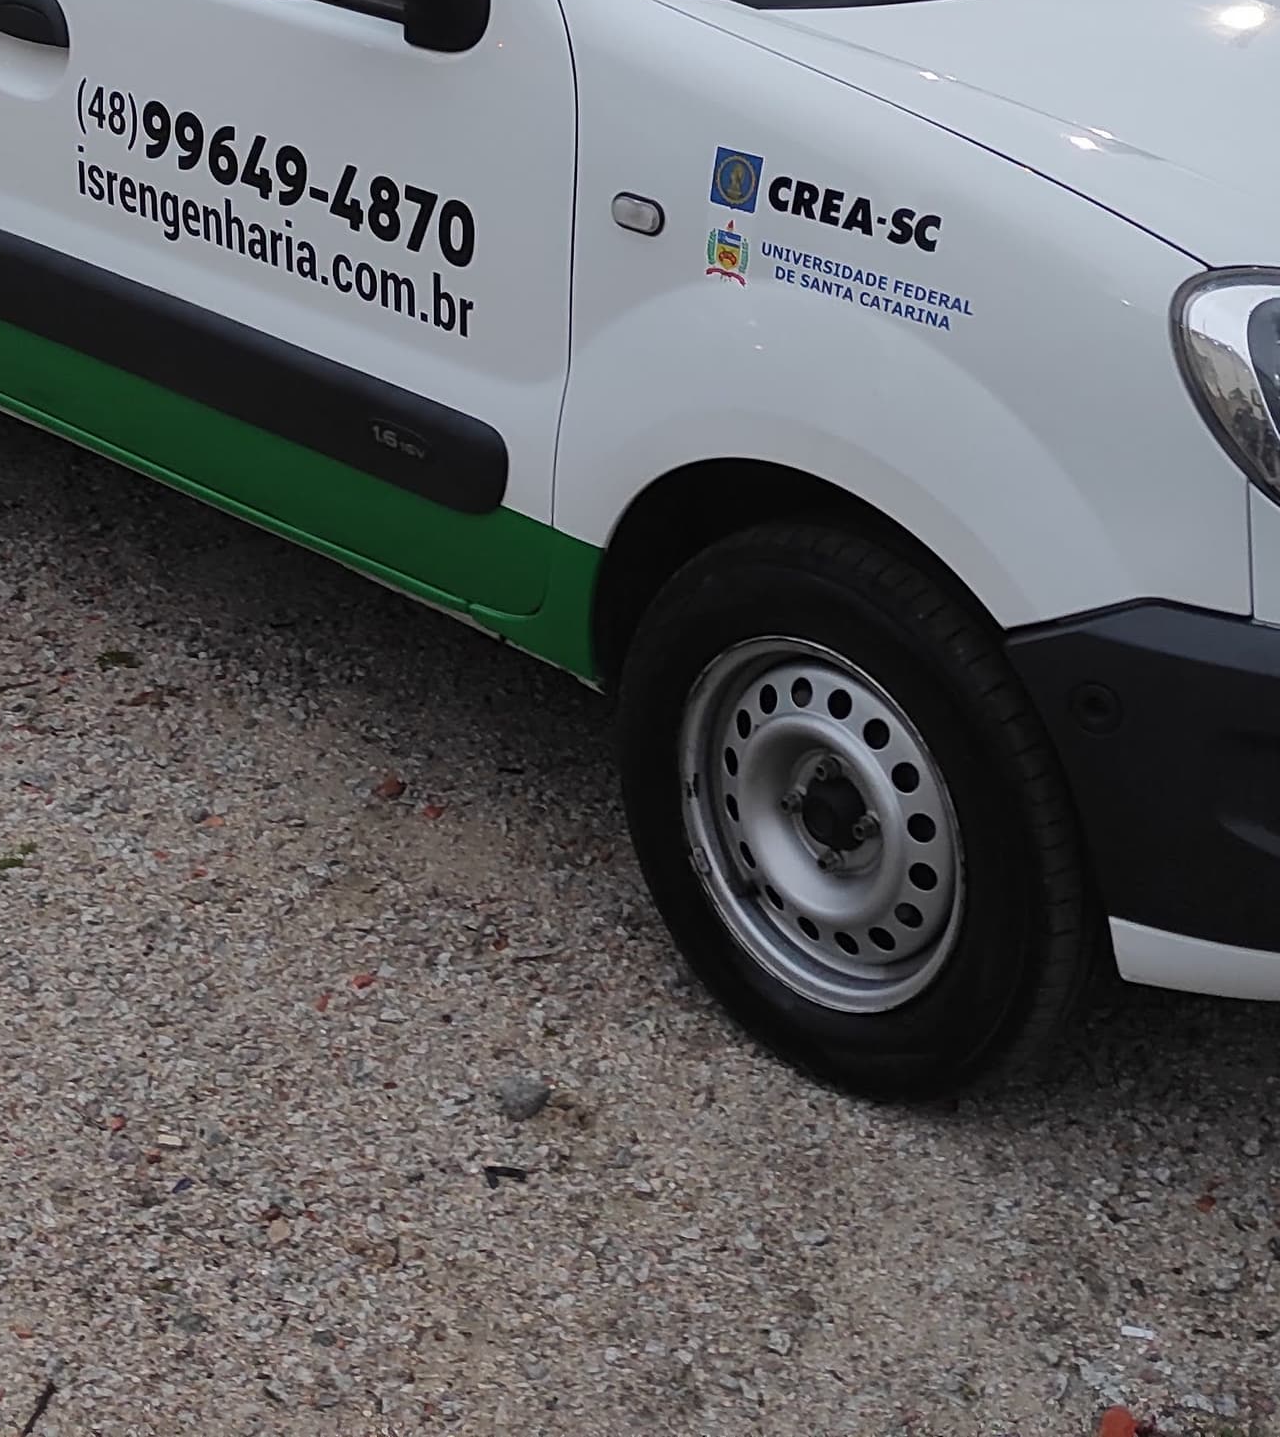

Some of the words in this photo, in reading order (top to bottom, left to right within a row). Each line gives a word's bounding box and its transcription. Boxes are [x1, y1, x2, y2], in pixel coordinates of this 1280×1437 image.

[77, 145, 474, 337] isrengenharia.com.br
[767, 176, 942, 253] CREA-SC
[761, 242, 888, 291] UNIVERSIDADE
[893, 280, 974, 316] FEDERAL
[775, 265, 796, 283] DE
[800, 274, 854, 302] SANTA
[859, 291, 951, 331] CATARINA
